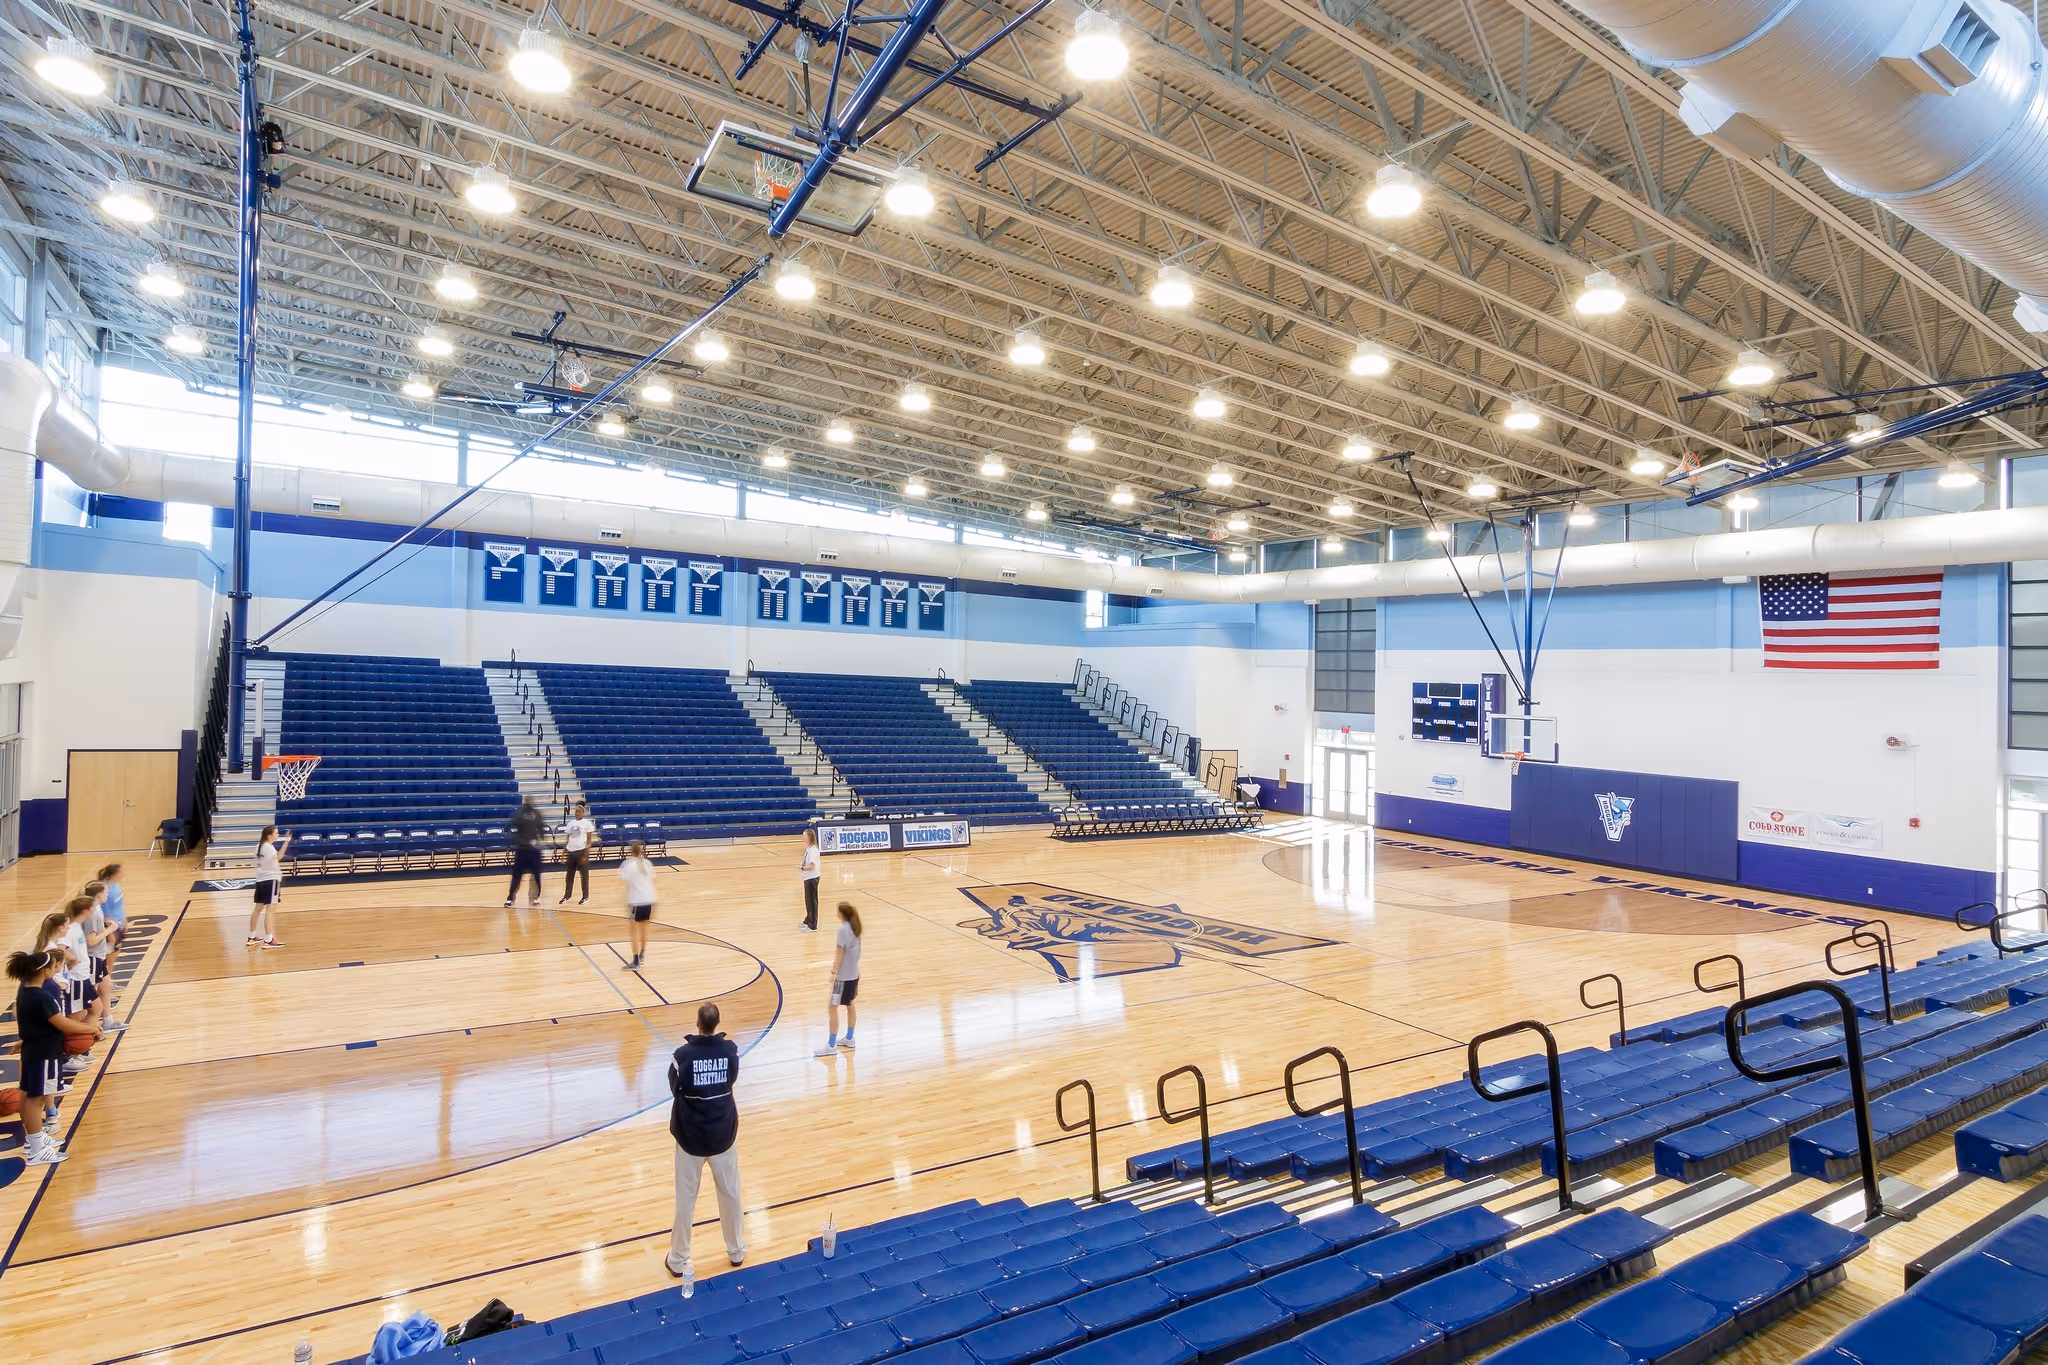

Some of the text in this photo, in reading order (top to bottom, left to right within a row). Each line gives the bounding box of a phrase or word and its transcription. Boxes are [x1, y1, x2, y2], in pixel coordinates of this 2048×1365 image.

[490, 544, 520, 552] CHEERLEADING
[1602, 800, 1615, 831] HOGGARD
[904, 828, 952, 843] VIKINGS
[1749, 821, 1772, 831] COLD
[1774, 824, 1805, 836] STONE
[839, 831, 888, 844] HOGGARD
[1591, 875, 1868, 927] VIKINGS
[1041, 894, 1277, 945] HOGGARD
[693, 1058, 728, 1072] HOGGARD
[694, 1071, 727, 1085] BASKETBALL
